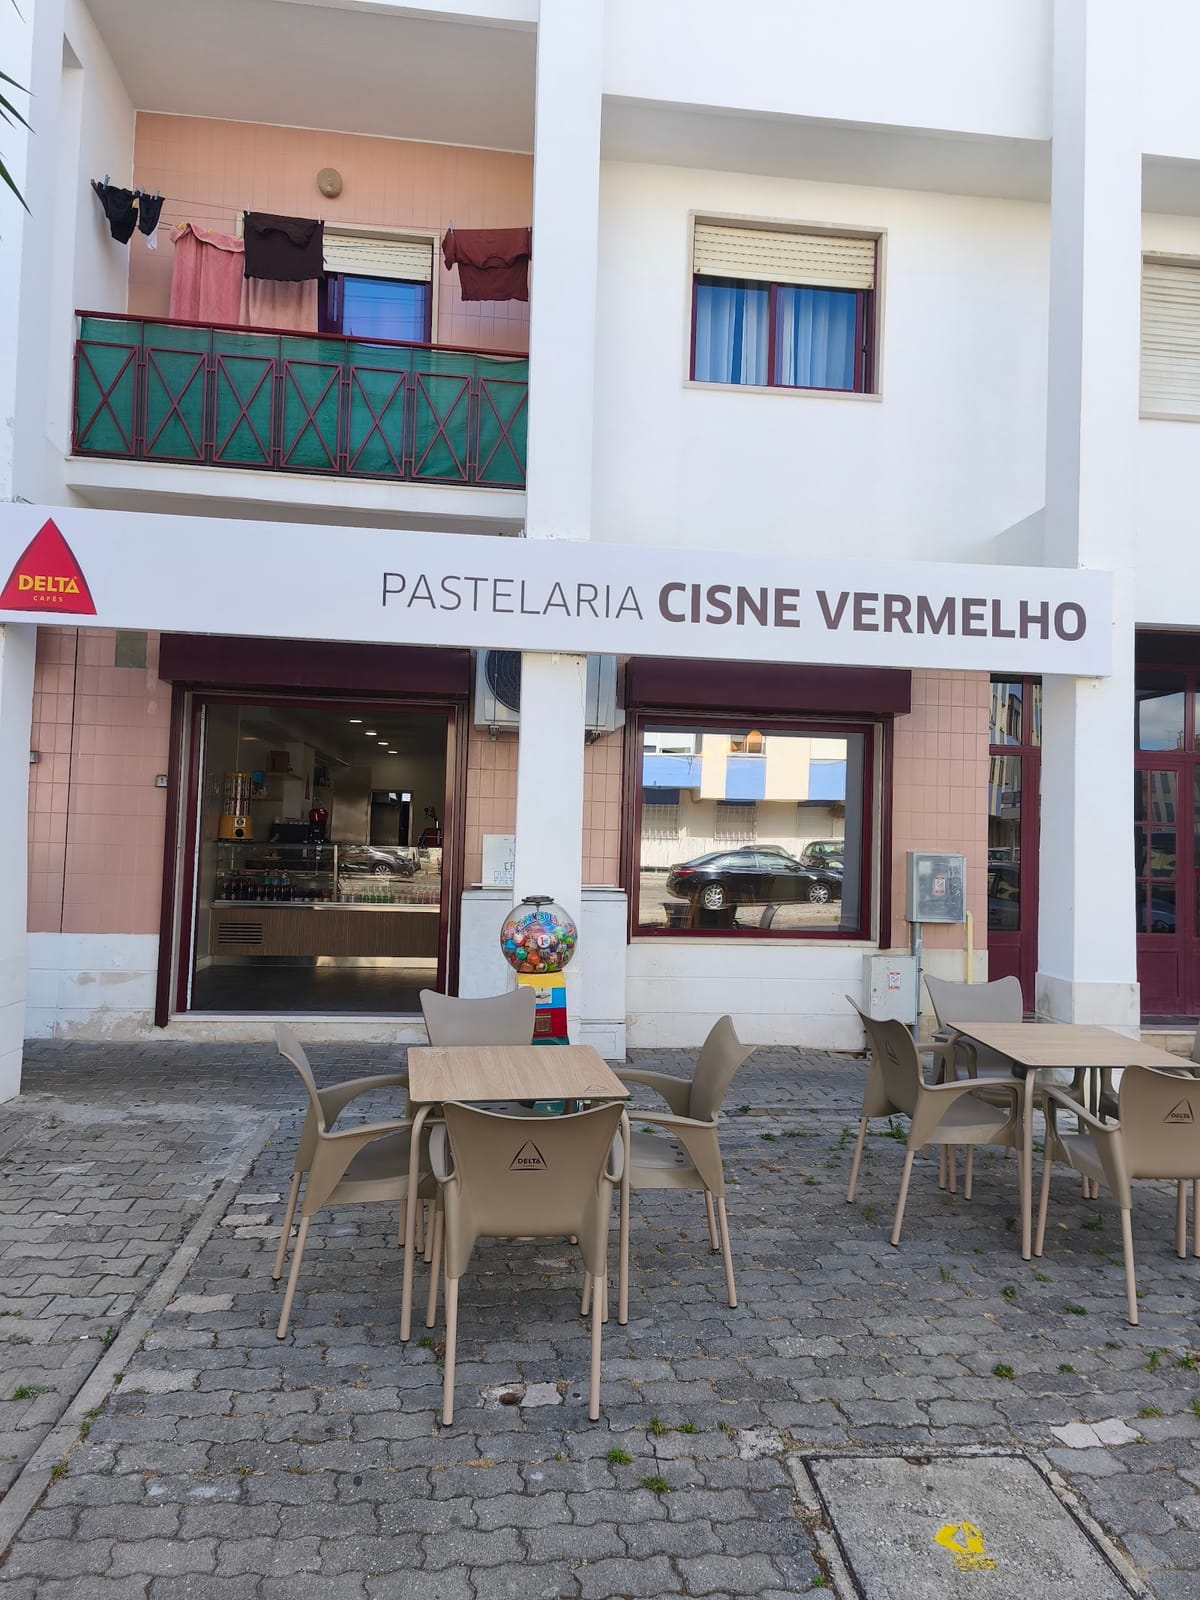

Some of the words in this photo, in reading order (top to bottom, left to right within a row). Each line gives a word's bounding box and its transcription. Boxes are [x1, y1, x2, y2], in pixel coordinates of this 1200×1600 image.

[18, 574, 80, 594] DELTA
[383, 572, 643, 620] PASTELARIA
[659, 582, 800, 627] CISNE
[816, 591, 1086, 641] VERMELHO
